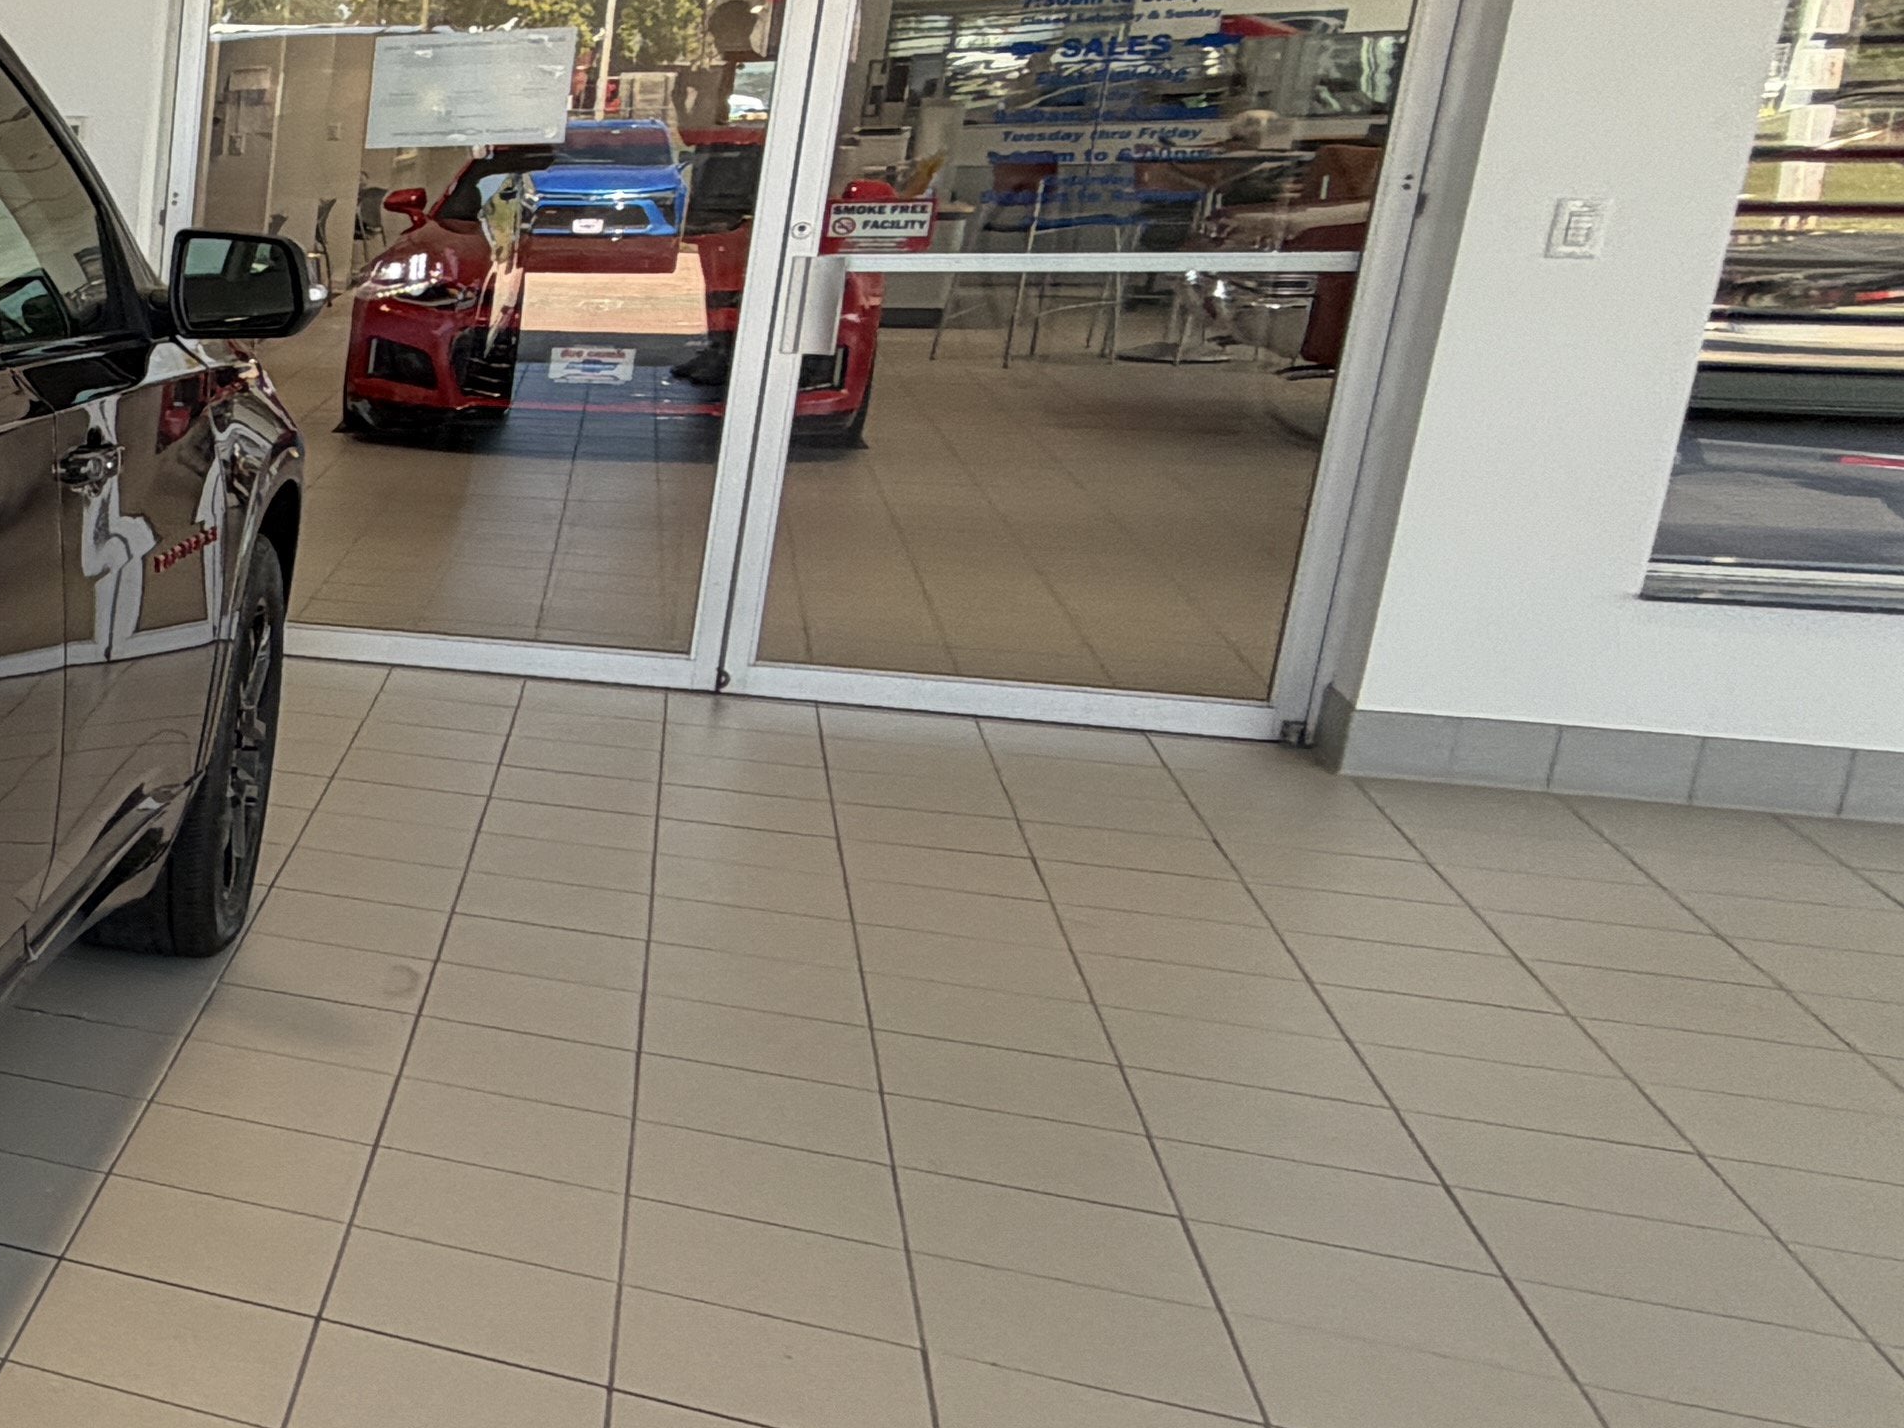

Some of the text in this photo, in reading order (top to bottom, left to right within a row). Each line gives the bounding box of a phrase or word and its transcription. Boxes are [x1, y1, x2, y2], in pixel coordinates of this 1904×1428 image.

[1165, 8, 1222, 19] Sunday
[1060, 33, 1173, 58] SALES
[1001, 127, 1203, 143] Tuesday thru Friday
[833, 204, 929, 215] SMOKE FREE
[861, 219, 927, 230] FACILITY
